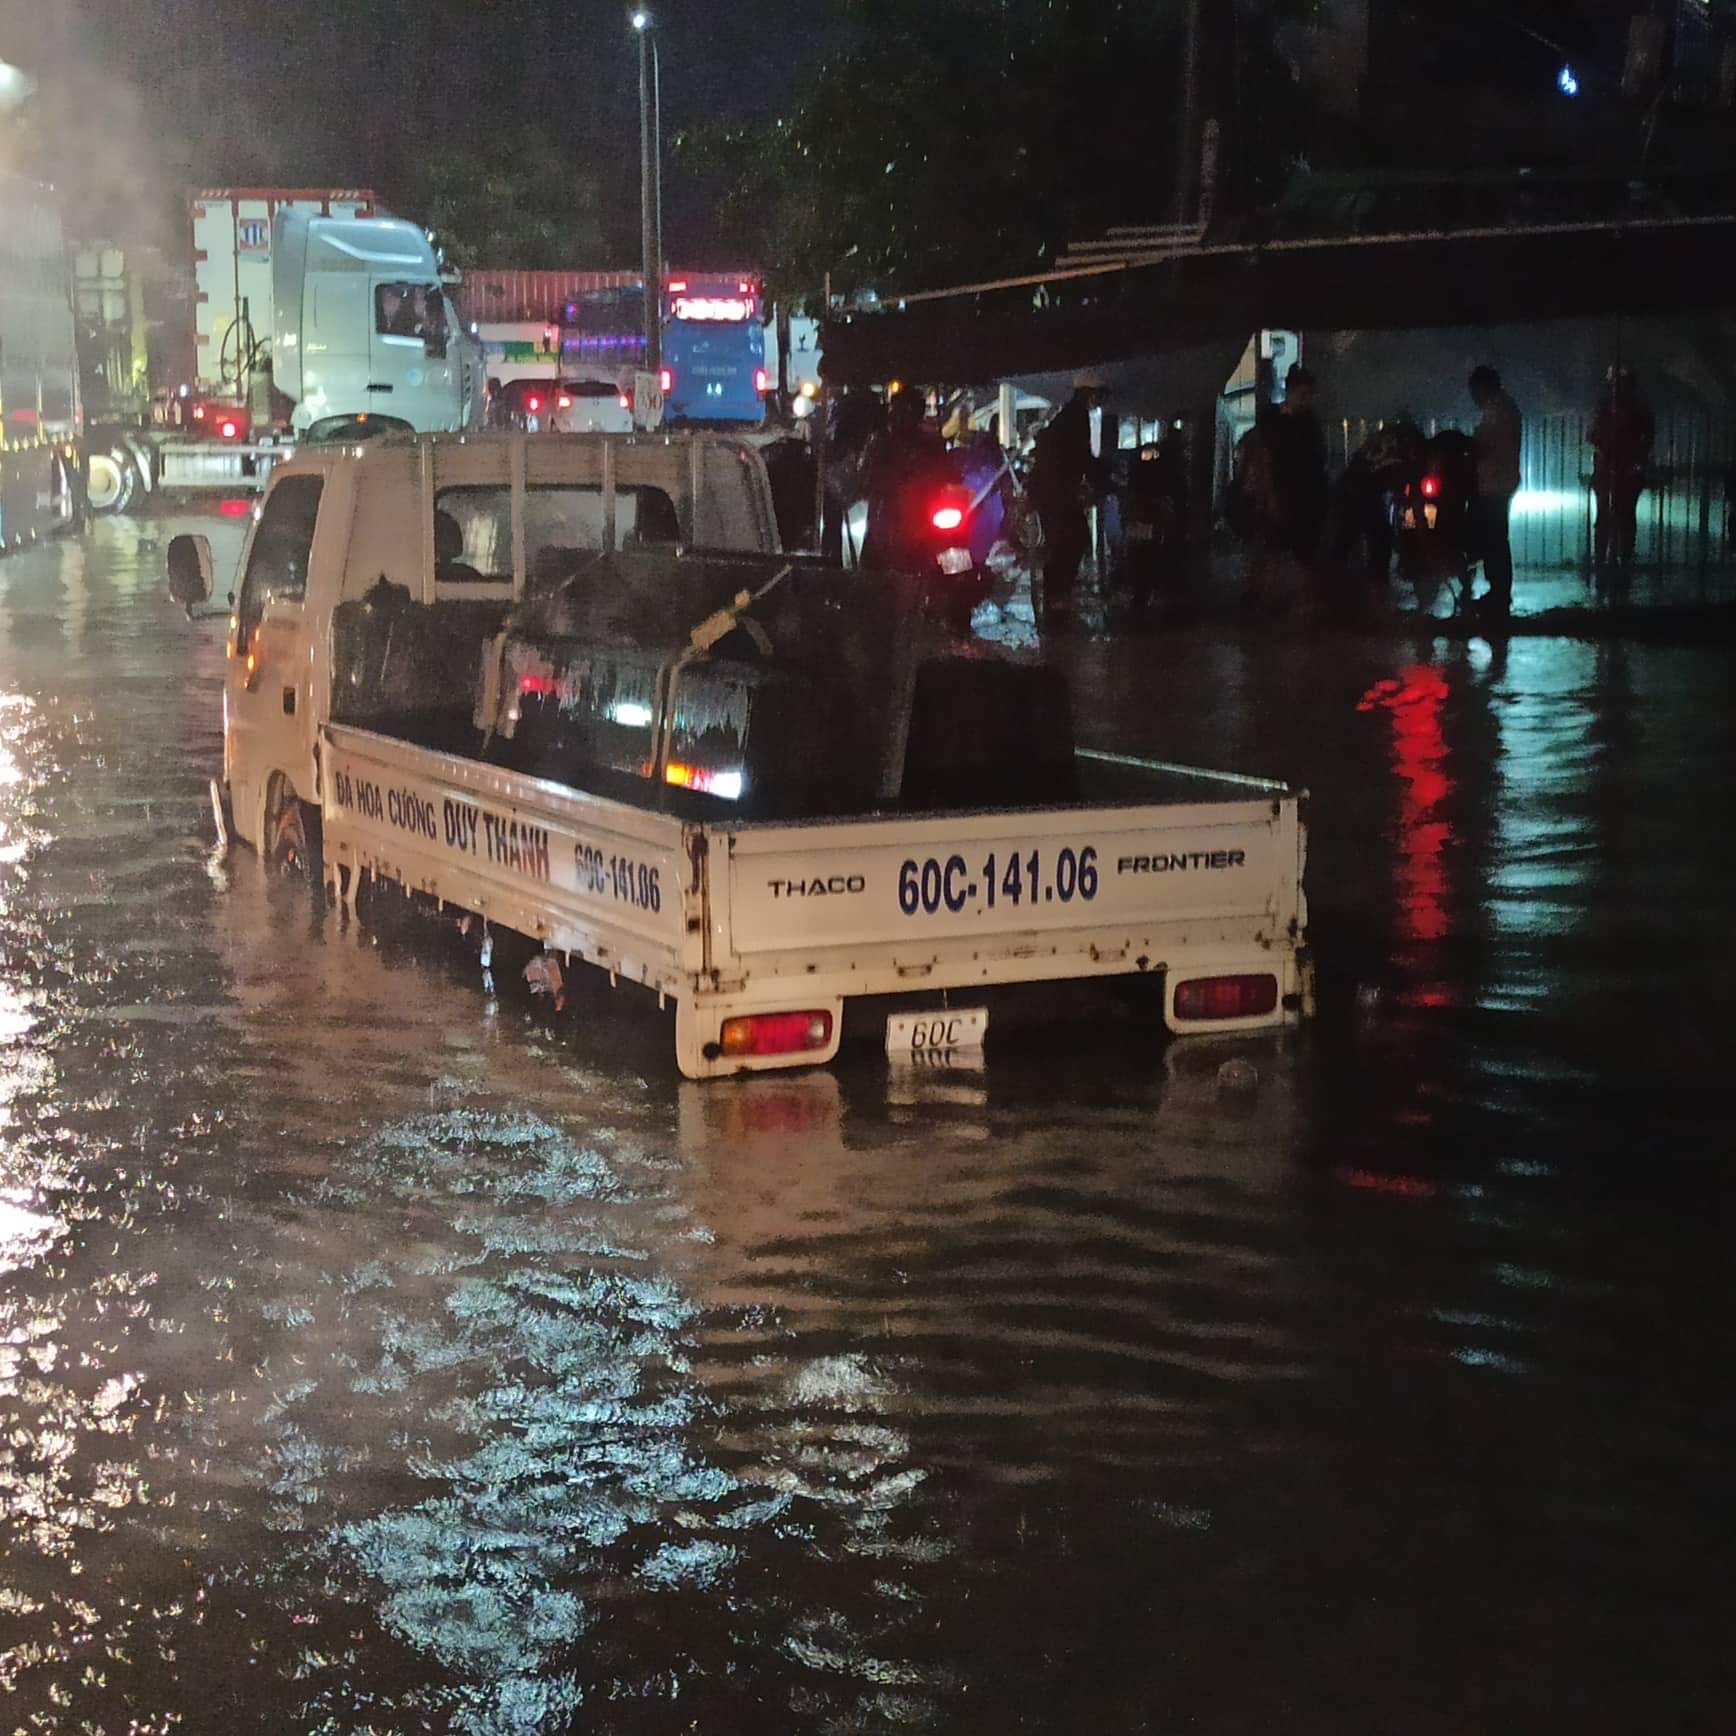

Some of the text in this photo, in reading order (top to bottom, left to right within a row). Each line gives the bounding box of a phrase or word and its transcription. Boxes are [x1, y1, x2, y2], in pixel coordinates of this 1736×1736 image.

[356, 776, 384, 822] HOA
[443, 799, 479, 857] DUY
[574, 843, 661, 914] 60C-141.06
[767, 875, 866, 898] THACO
[898, 846, 1099, 916] 60C-141.06
[1117, 848, 1246, 875] FRONTIER
[911, 1019, 962, 1049] 60C
